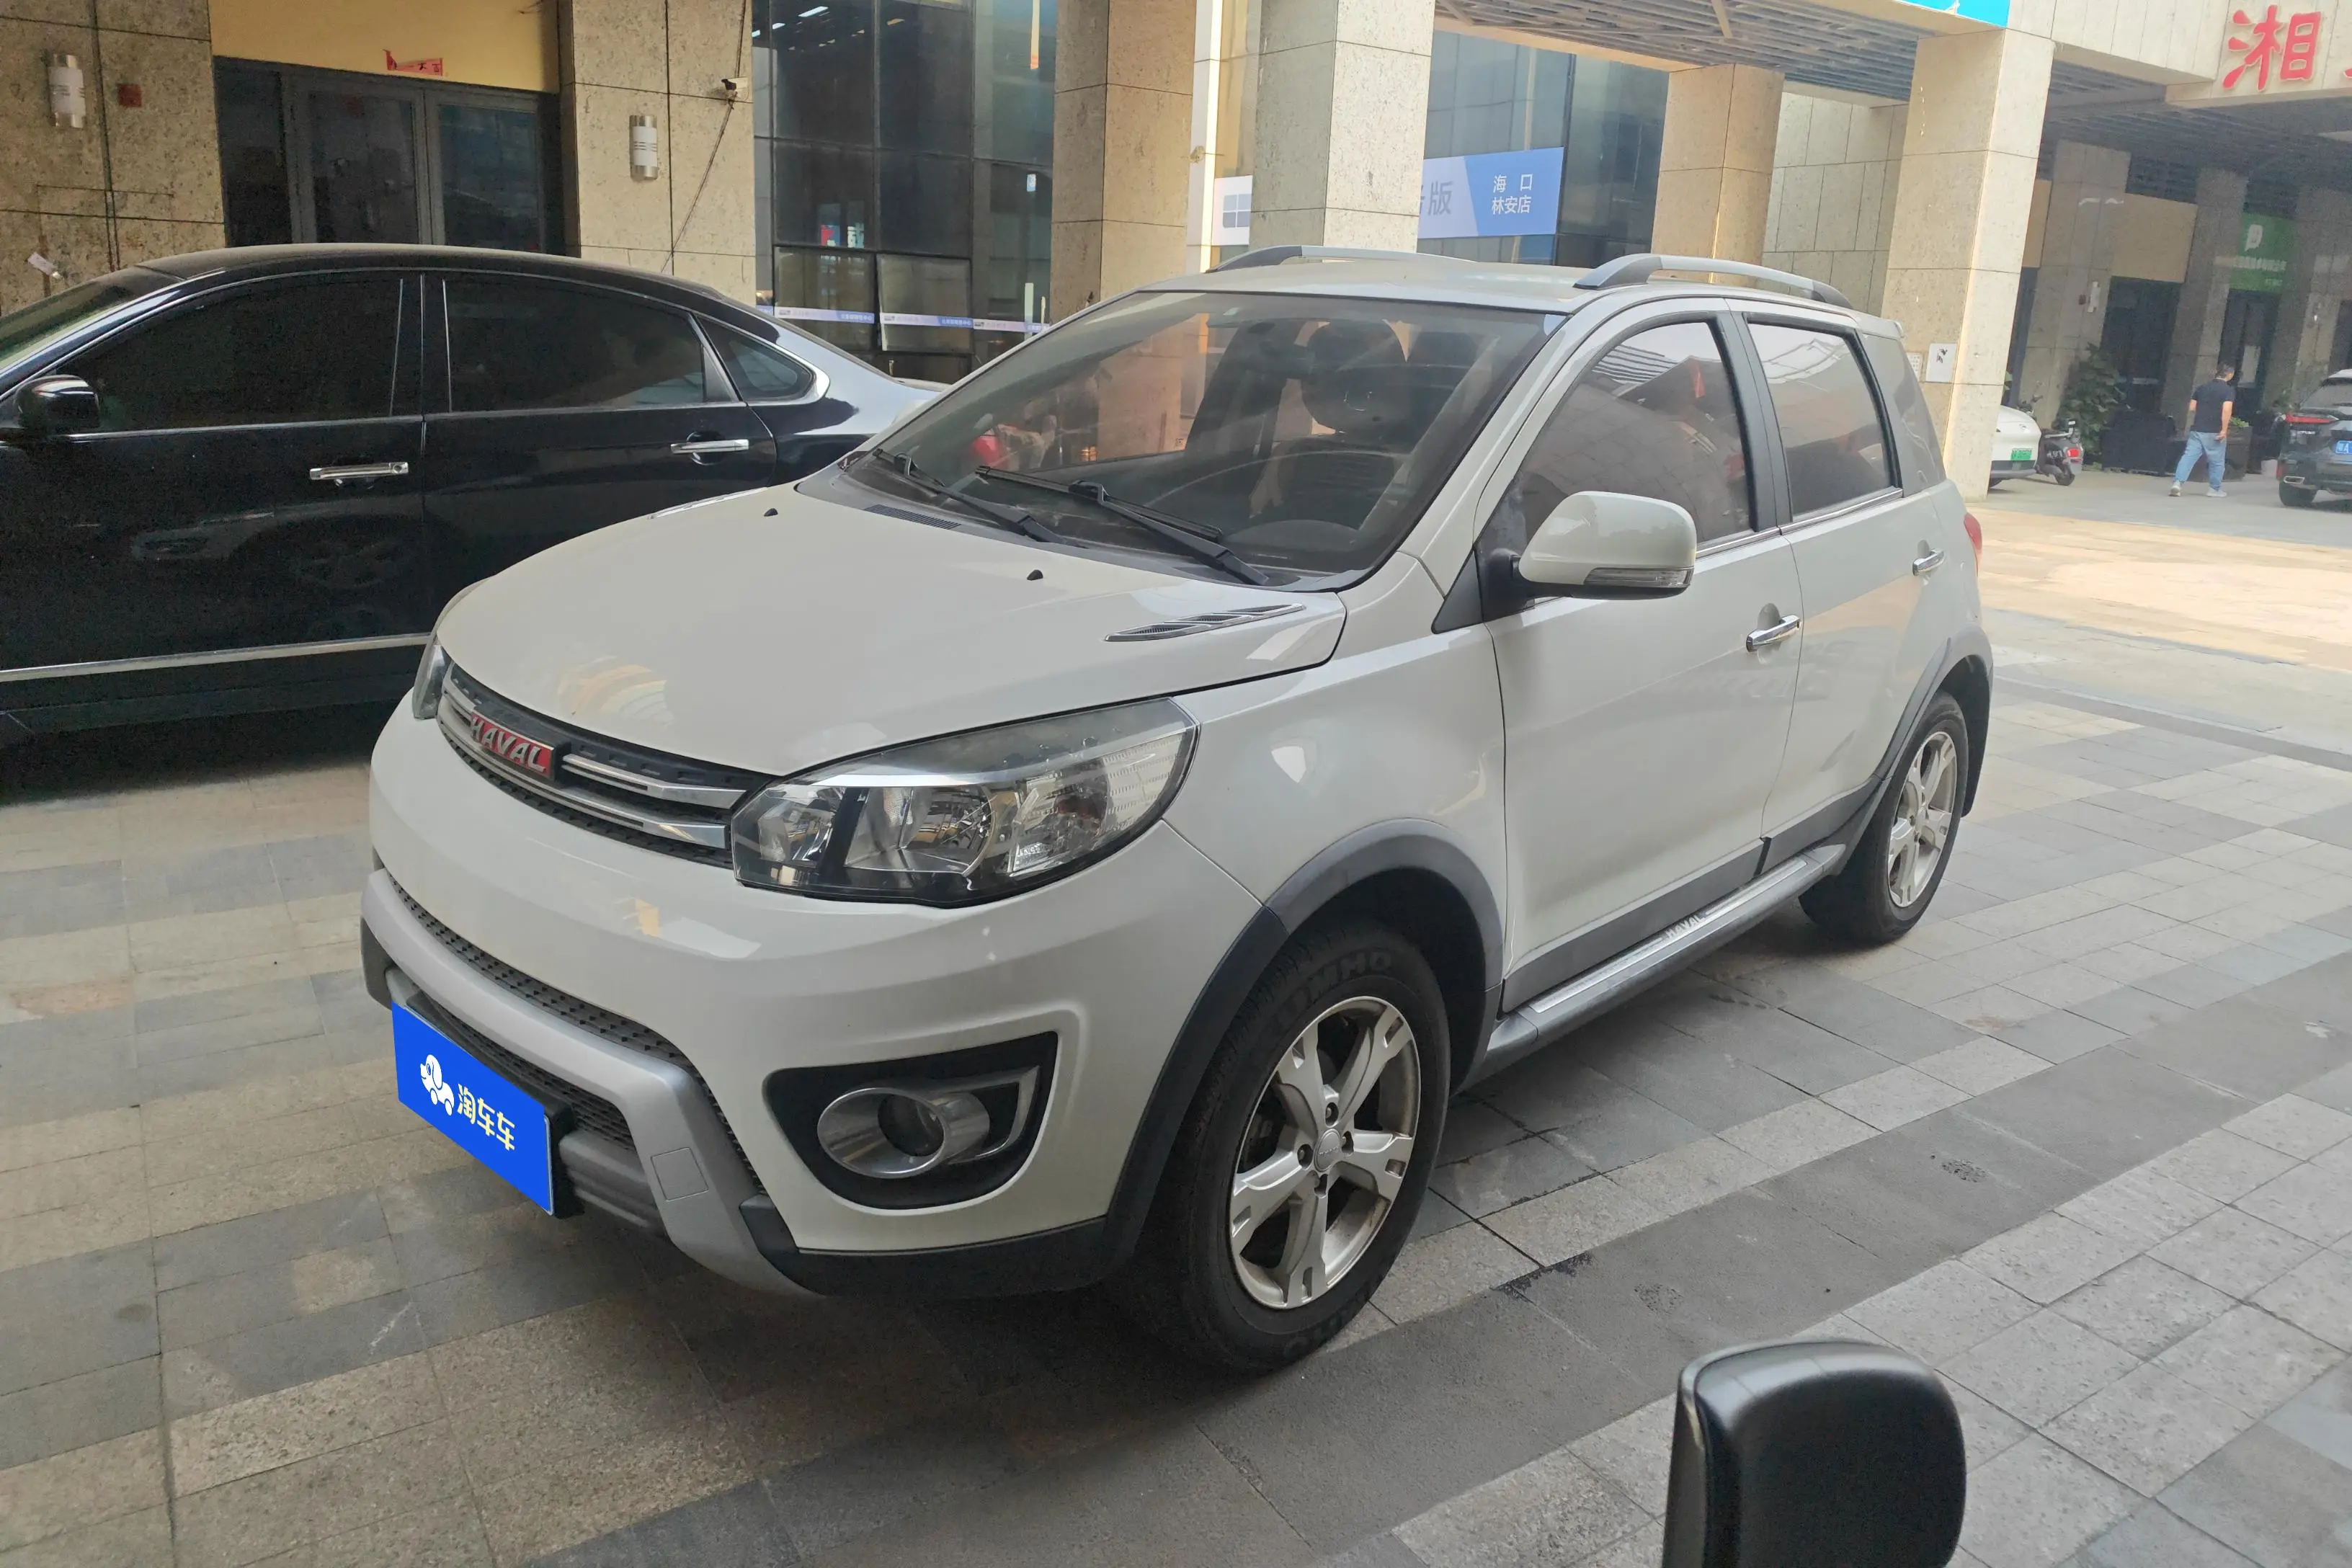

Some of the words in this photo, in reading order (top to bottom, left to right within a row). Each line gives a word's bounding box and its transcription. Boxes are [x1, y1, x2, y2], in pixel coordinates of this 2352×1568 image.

[2222, 4, 2352, 92] 湘
[1420, 180, 1453, 215] 版
[1492, 173, 1533, 193] 海口
[1491, 195, 1532, 215] 林安店
[471, 716, 546, 773] HAVAL
[1665, 914, 1705, 939] HAVAL
